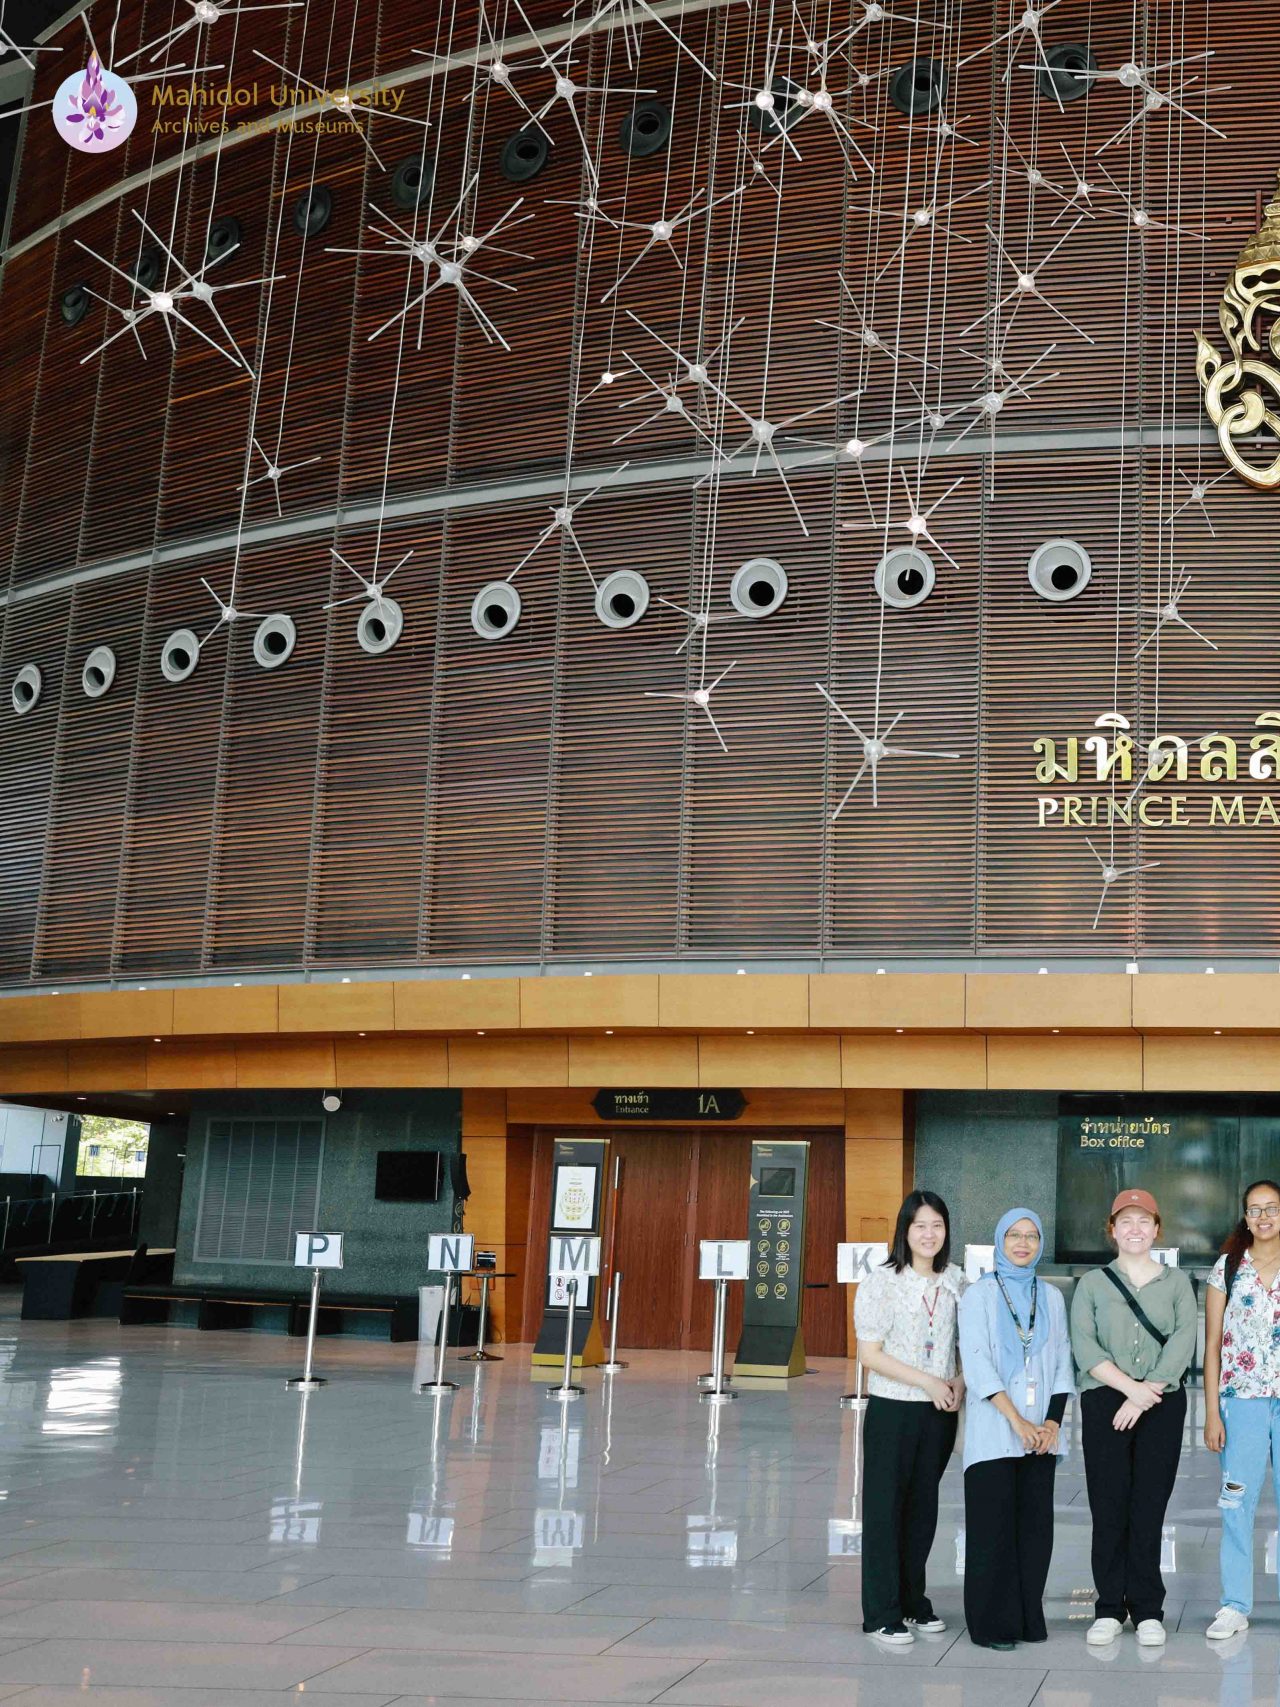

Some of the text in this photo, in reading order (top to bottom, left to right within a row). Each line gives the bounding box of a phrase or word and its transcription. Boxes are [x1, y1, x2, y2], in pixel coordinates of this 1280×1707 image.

[1037, 795, 1191, 828] PRINCE
[697, 1094, 720, 1114] 1A
[1080, 1116, 1171, 1135] จำหน่ายบัตร
[1080, 1135, 1145, 1148] Box office
[307, 1234, 330, 1265] P
[440, 1238, 461, 1270] N
[559, 1239, 591, 1271] M
[716, 1244, 734, 1276] L
[852, 1247, 873, 1279] K
